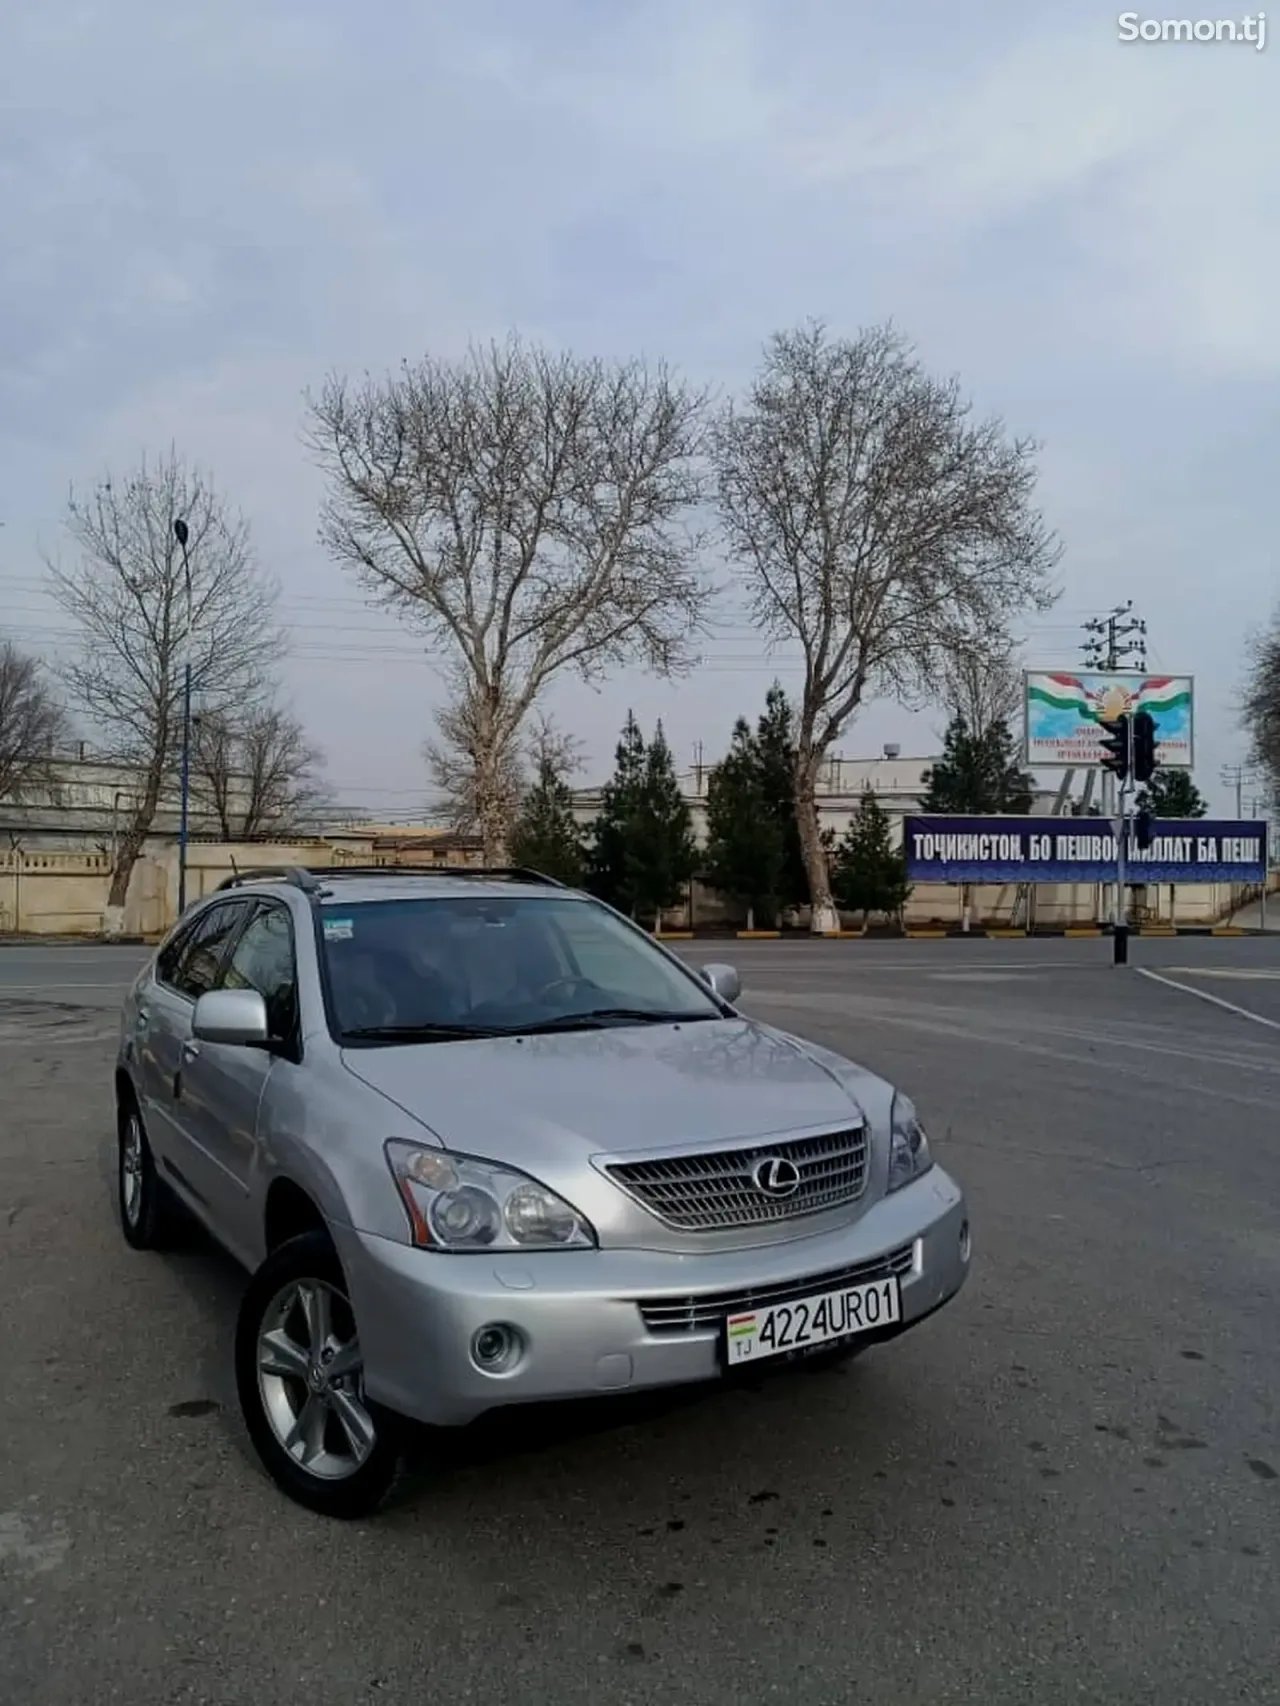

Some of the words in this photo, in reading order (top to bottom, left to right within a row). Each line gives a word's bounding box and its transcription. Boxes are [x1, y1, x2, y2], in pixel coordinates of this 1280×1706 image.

[913, 834, 1025, 864] ТОҶИКИСТОН,
[1029, 835, 1050, 861] БО
[1197, 837, 1218, 862] БА
[1222, 837, 1260, 862] ПЕШ!
[759, 1282, 893, 1350] 4224UR01
[736, 1339, 752, 1357] TJ
